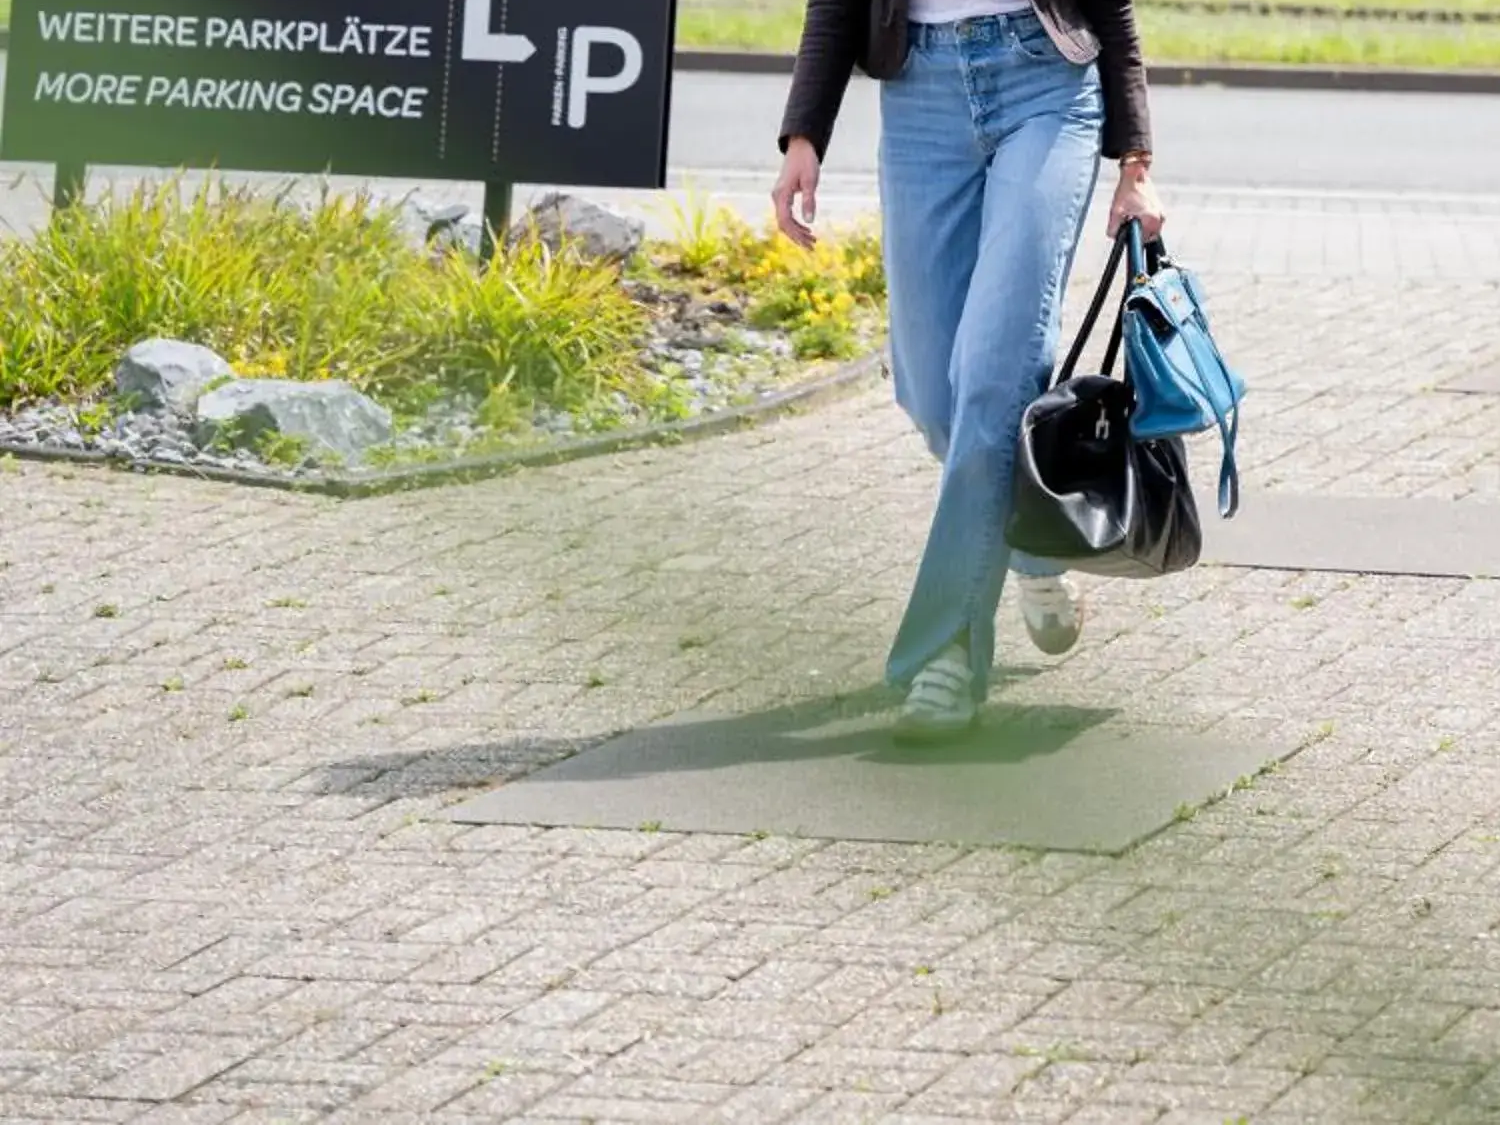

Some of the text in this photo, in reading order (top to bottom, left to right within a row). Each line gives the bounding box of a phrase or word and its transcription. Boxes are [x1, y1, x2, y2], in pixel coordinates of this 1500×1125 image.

[38, 11, 432, 57] WEITERE PARKPLÄTZE
[34, 72, 428, 119] MORE PARKING SPACE
[567, 25, 643, 129] P
